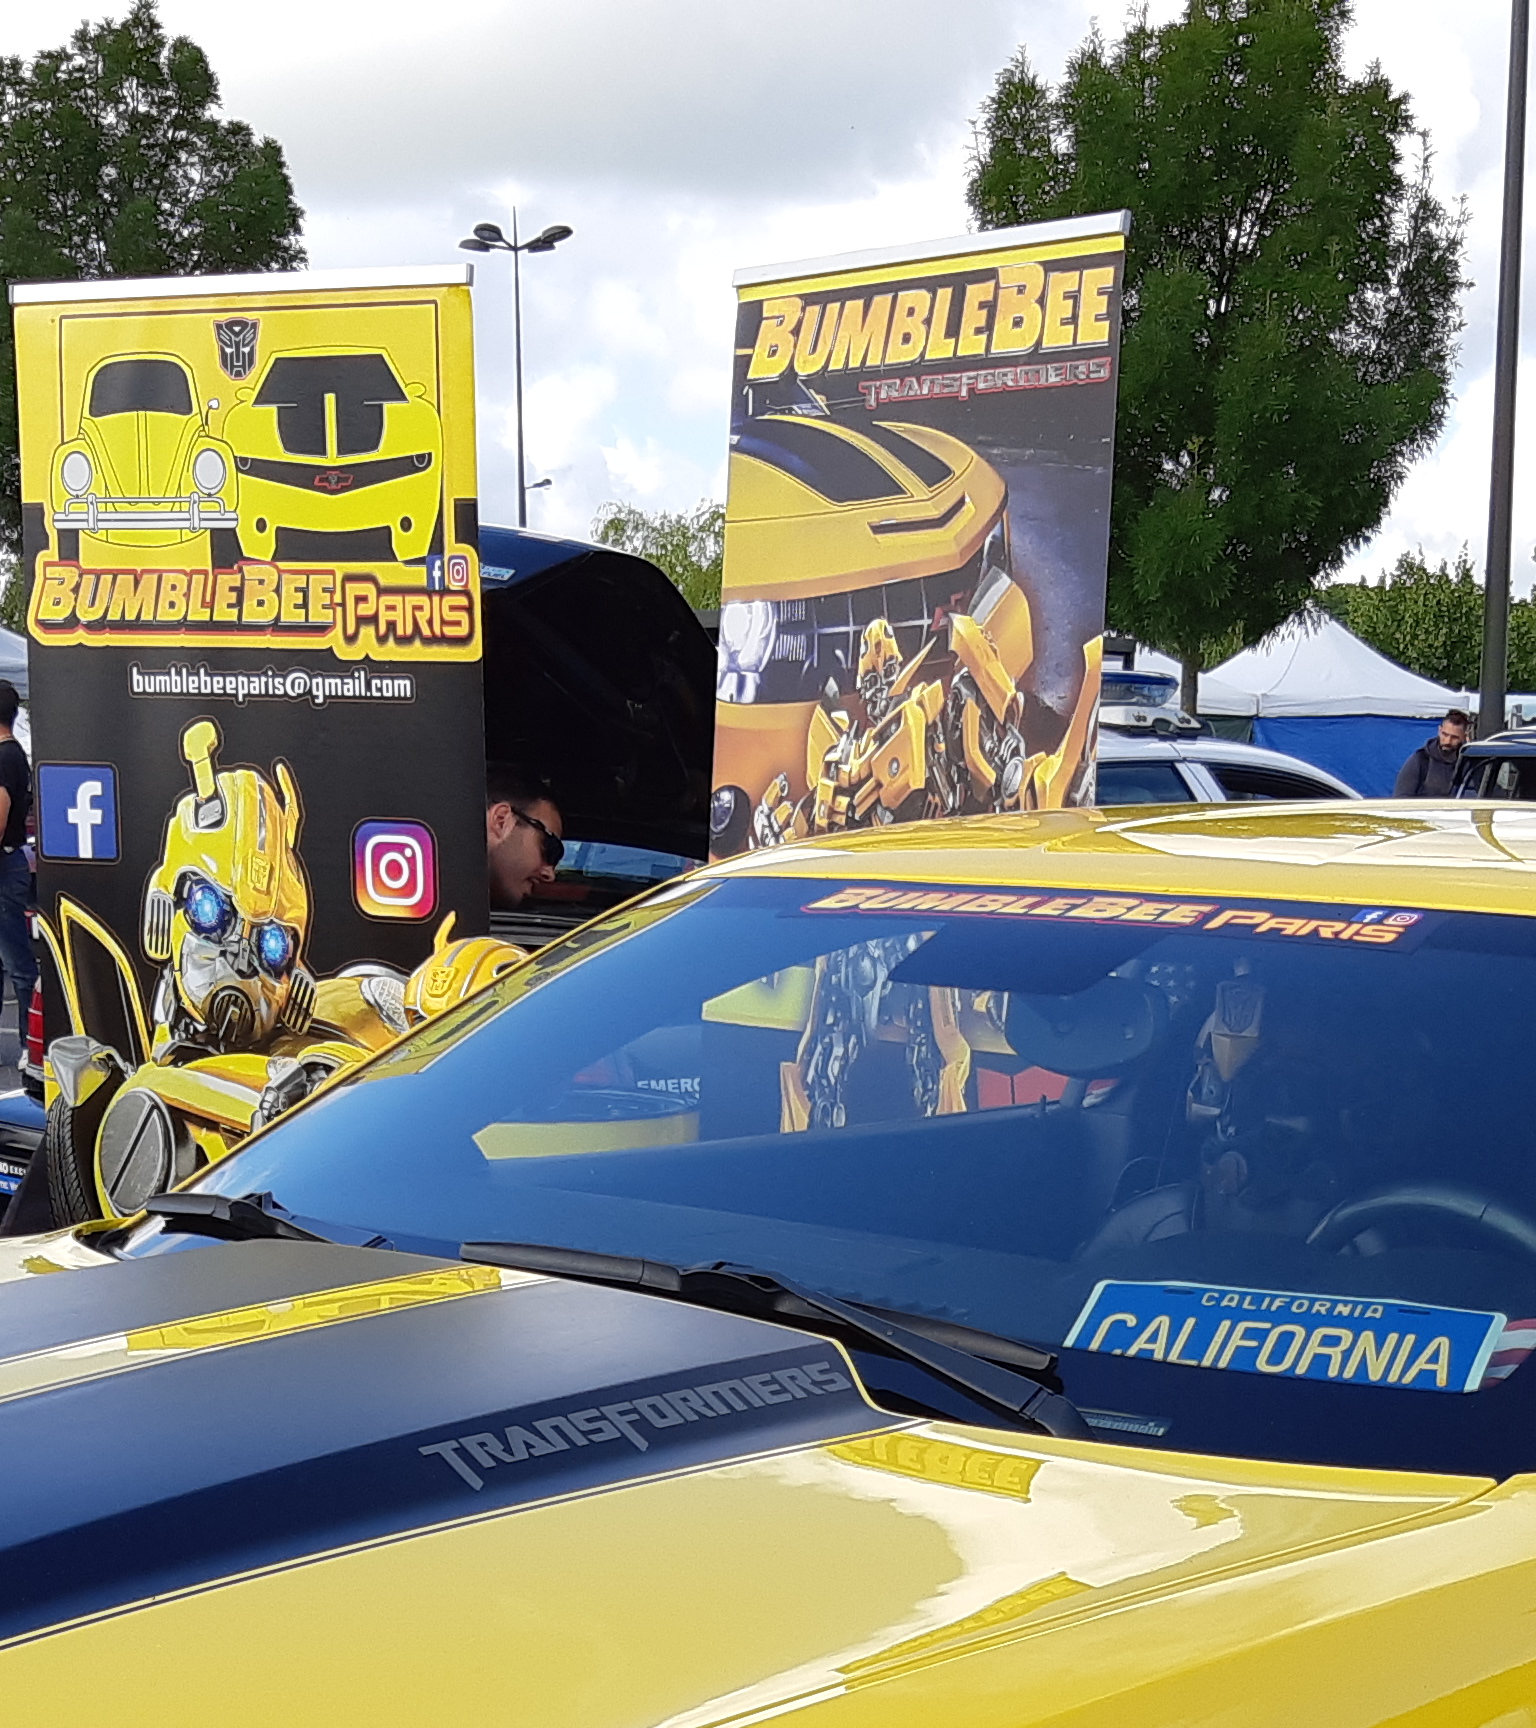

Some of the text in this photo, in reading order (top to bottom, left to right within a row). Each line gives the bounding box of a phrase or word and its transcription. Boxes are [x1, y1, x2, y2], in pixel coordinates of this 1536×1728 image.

[747, 262, 1115, 381] BUMBLEBEE
[861, 359, 1111, 409] TRANSFORMERS
[36, 564, 471, 638] BUMBLEBEE PARIS
[132, 665, 411, 704] bumblebeeparis@gmail.com
[806, 887, 1406, 943] BUMBLEBEE PARIS
[1201, 1291, 1385, 1319] CALIFORNIA
[1088, 1312, 1451, 1387] CALIFORNIA
[419, 1361, 852, 1491] TRANSFORMERS
